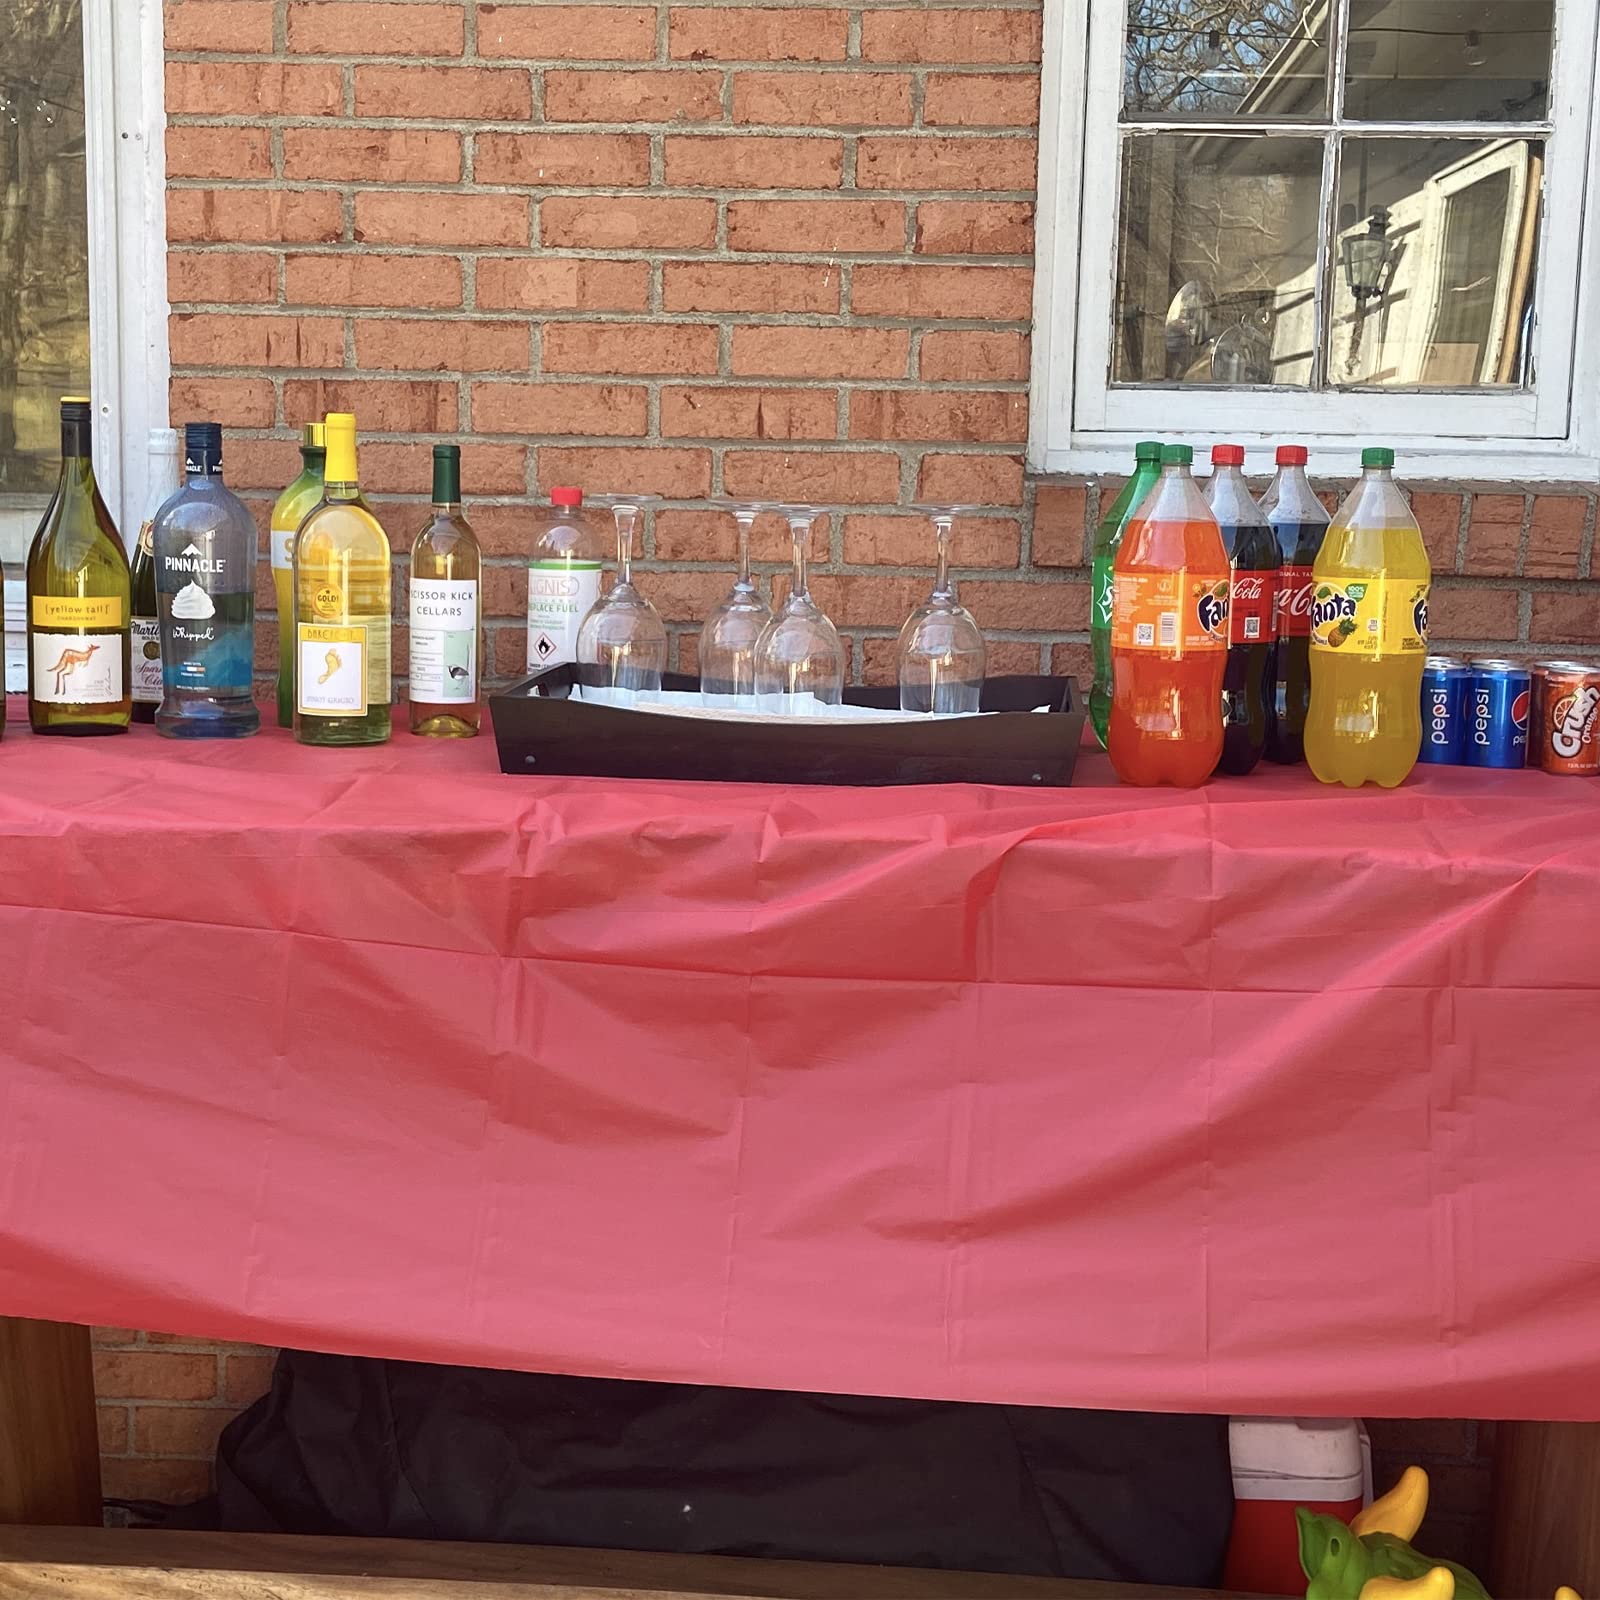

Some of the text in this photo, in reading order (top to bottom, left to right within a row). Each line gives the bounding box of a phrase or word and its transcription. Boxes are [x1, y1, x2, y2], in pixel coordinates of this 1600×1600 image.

[165, 556, 224, 573] PINNACLE
[410, 590, 473, 600] SCISSOR KICK
[416, 606, 462, 616] CELLARS
[556, 603, 579, 613] FUEL
[172, 627, 215, 641] Whipped
[1430, 688, 1450, 745] pepsi
[1474, 688, 1492, 745] pepsi
